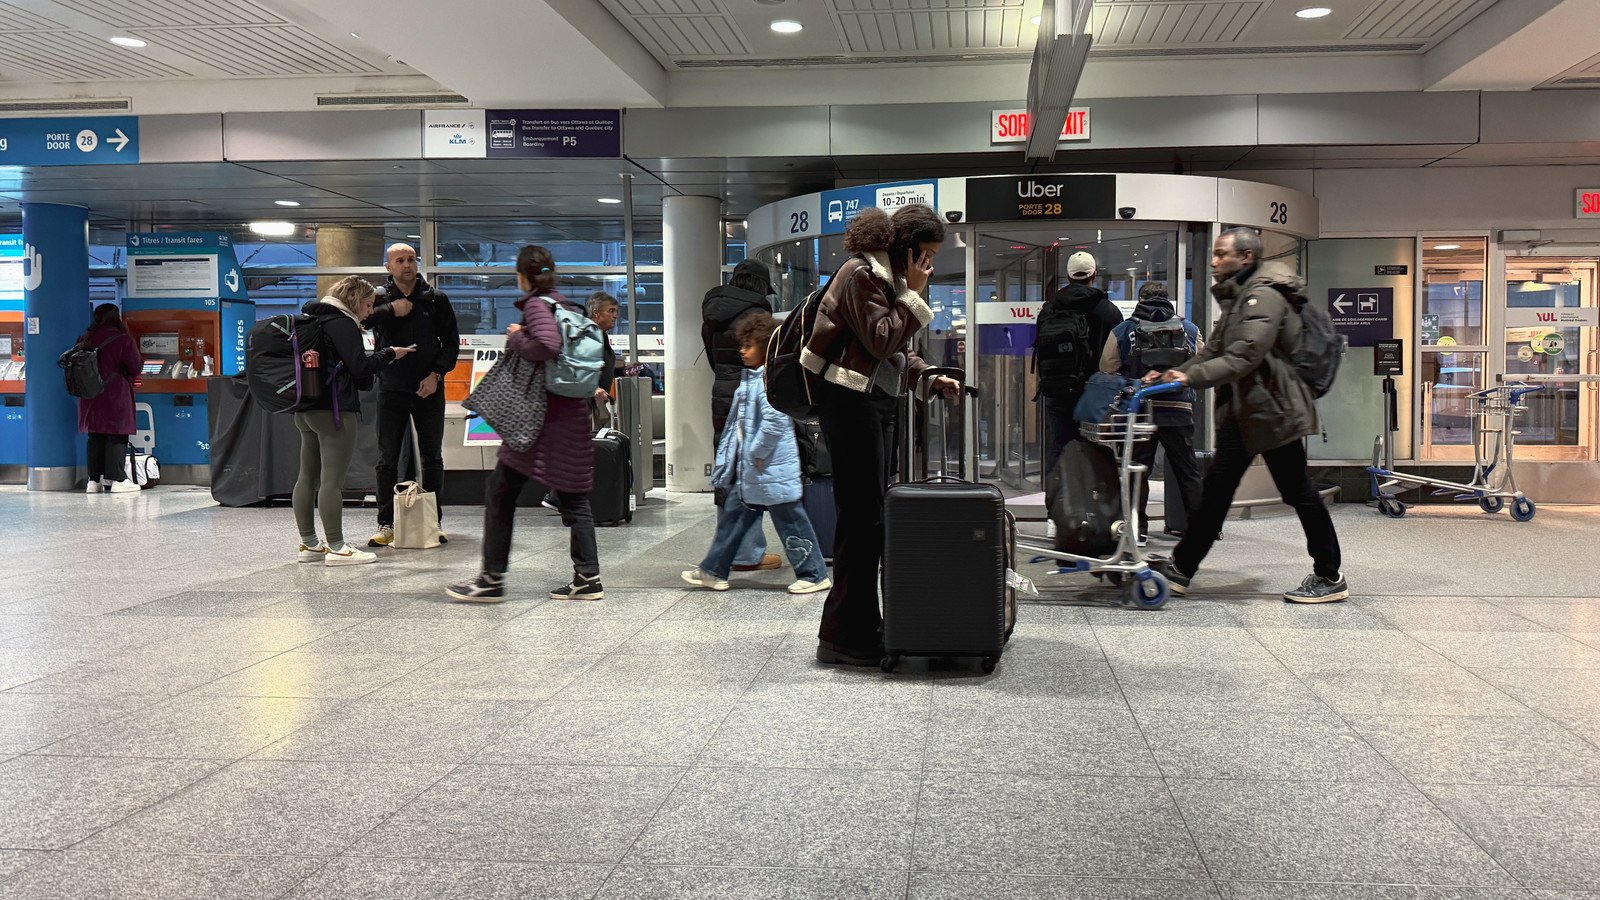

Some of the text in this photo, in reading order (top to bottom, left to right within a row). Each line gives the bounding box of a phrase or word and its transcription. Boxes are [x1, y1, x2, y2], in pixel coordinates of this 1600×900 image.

[1061, 111, 1086, 135] XIT
[46, 133, 70, 141] PORTE
[80, 136, 93, 146] 28
[562, 136, 577, 146] P5
[47, 141, 70, 150] DOOR
[1017, 181, 1064, 198] Uber
[845, 199, 859, 210] 747
[882, 196, 906, 207] 10-20
[1044, 203, 1062, 215] 28
[1269, 201, 1287, 224] 28
[790, 210, 809, 234] 28
[142, 236, 160, 244] Titres
[165, 236, 186, 244] Transit
[187, 236, 203, 244] fares
[1010, 307, 1034, 318] YUL
[1536, 312, 1558, 322] YUL
[235, 319, 245, 372] sit fares
